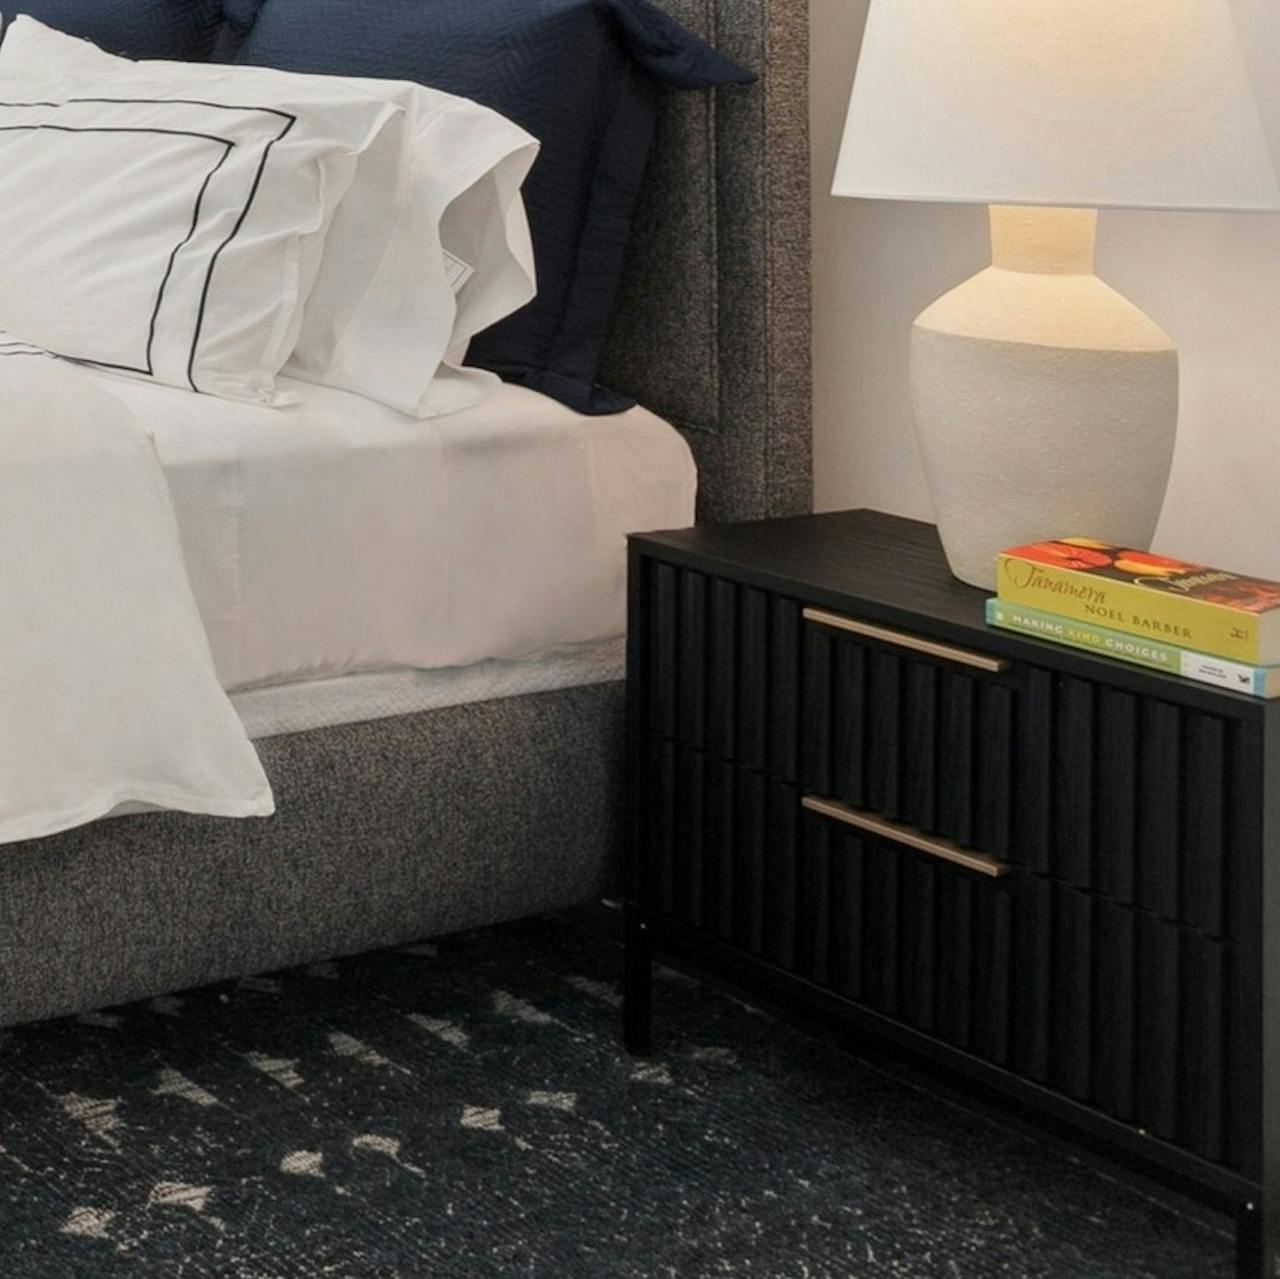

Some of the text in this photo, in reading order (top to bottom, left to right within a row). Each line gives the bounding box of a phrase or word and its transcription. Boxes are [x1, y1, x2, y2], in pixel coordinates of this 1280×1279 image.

[1006, 559, 1108, 603] Tanamera
[1013, 615, 1064, 634] MAKING
[1068, 629, 1101, 644] KIND
[1105, 637, 1168, 661] CHOICES
[1084, 603, 1193, 640] NOEL BARBER
